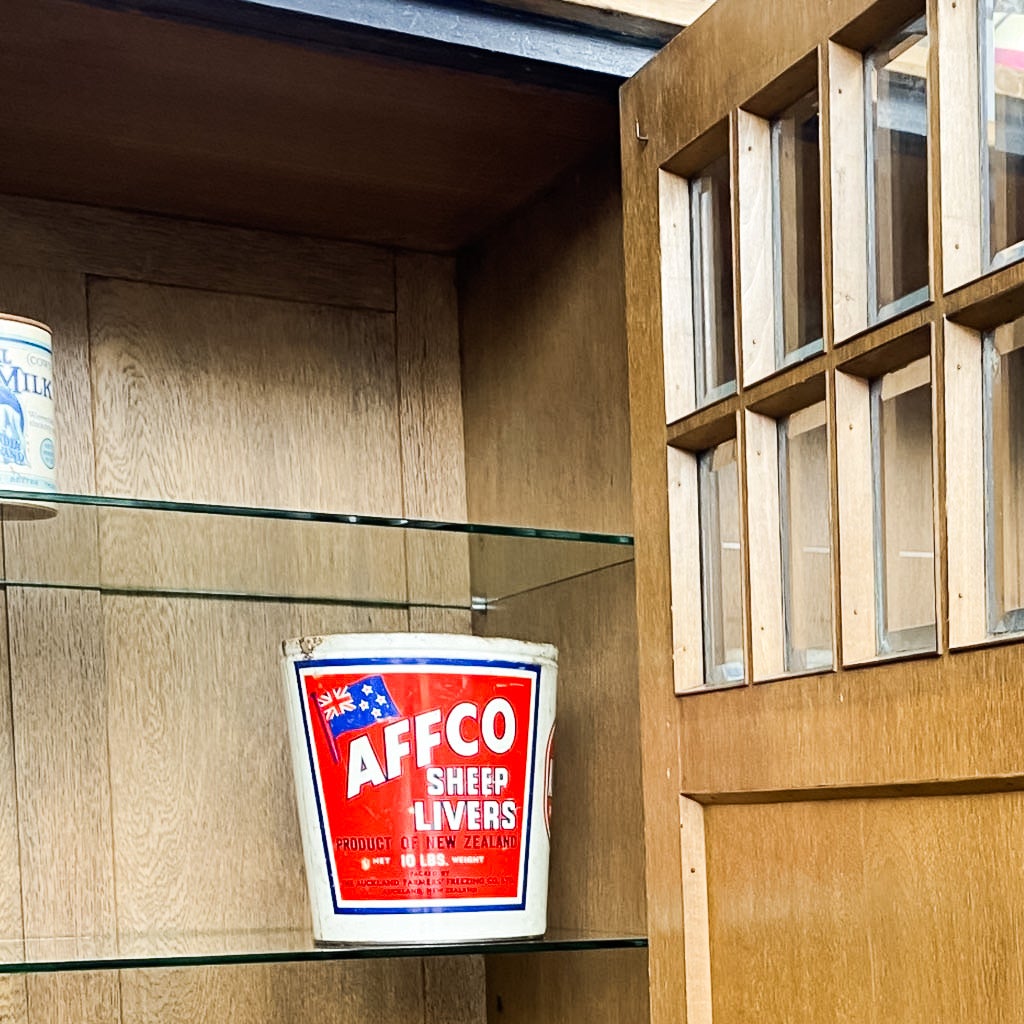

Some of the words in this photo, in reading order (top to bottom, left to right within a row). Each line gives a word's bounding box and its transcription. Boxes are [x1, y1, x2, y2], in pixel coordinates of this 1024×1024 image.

[347, 697, 517, 799] AFFCO
[426, 767, 508, 797] SHEEP
[414, 800, 518, 831] LIVERS
[336, 836, 392, 851] PRODUCT
[401, 836, 418, 850] OF
[427, 835, 457, 849] NEW
[463, 835, 518, 849] ZEALAND
[372, 856, 391, 865] NET
[401, 853, 416, 869] 10
[451, 855, 485, 864] WEIGHT
